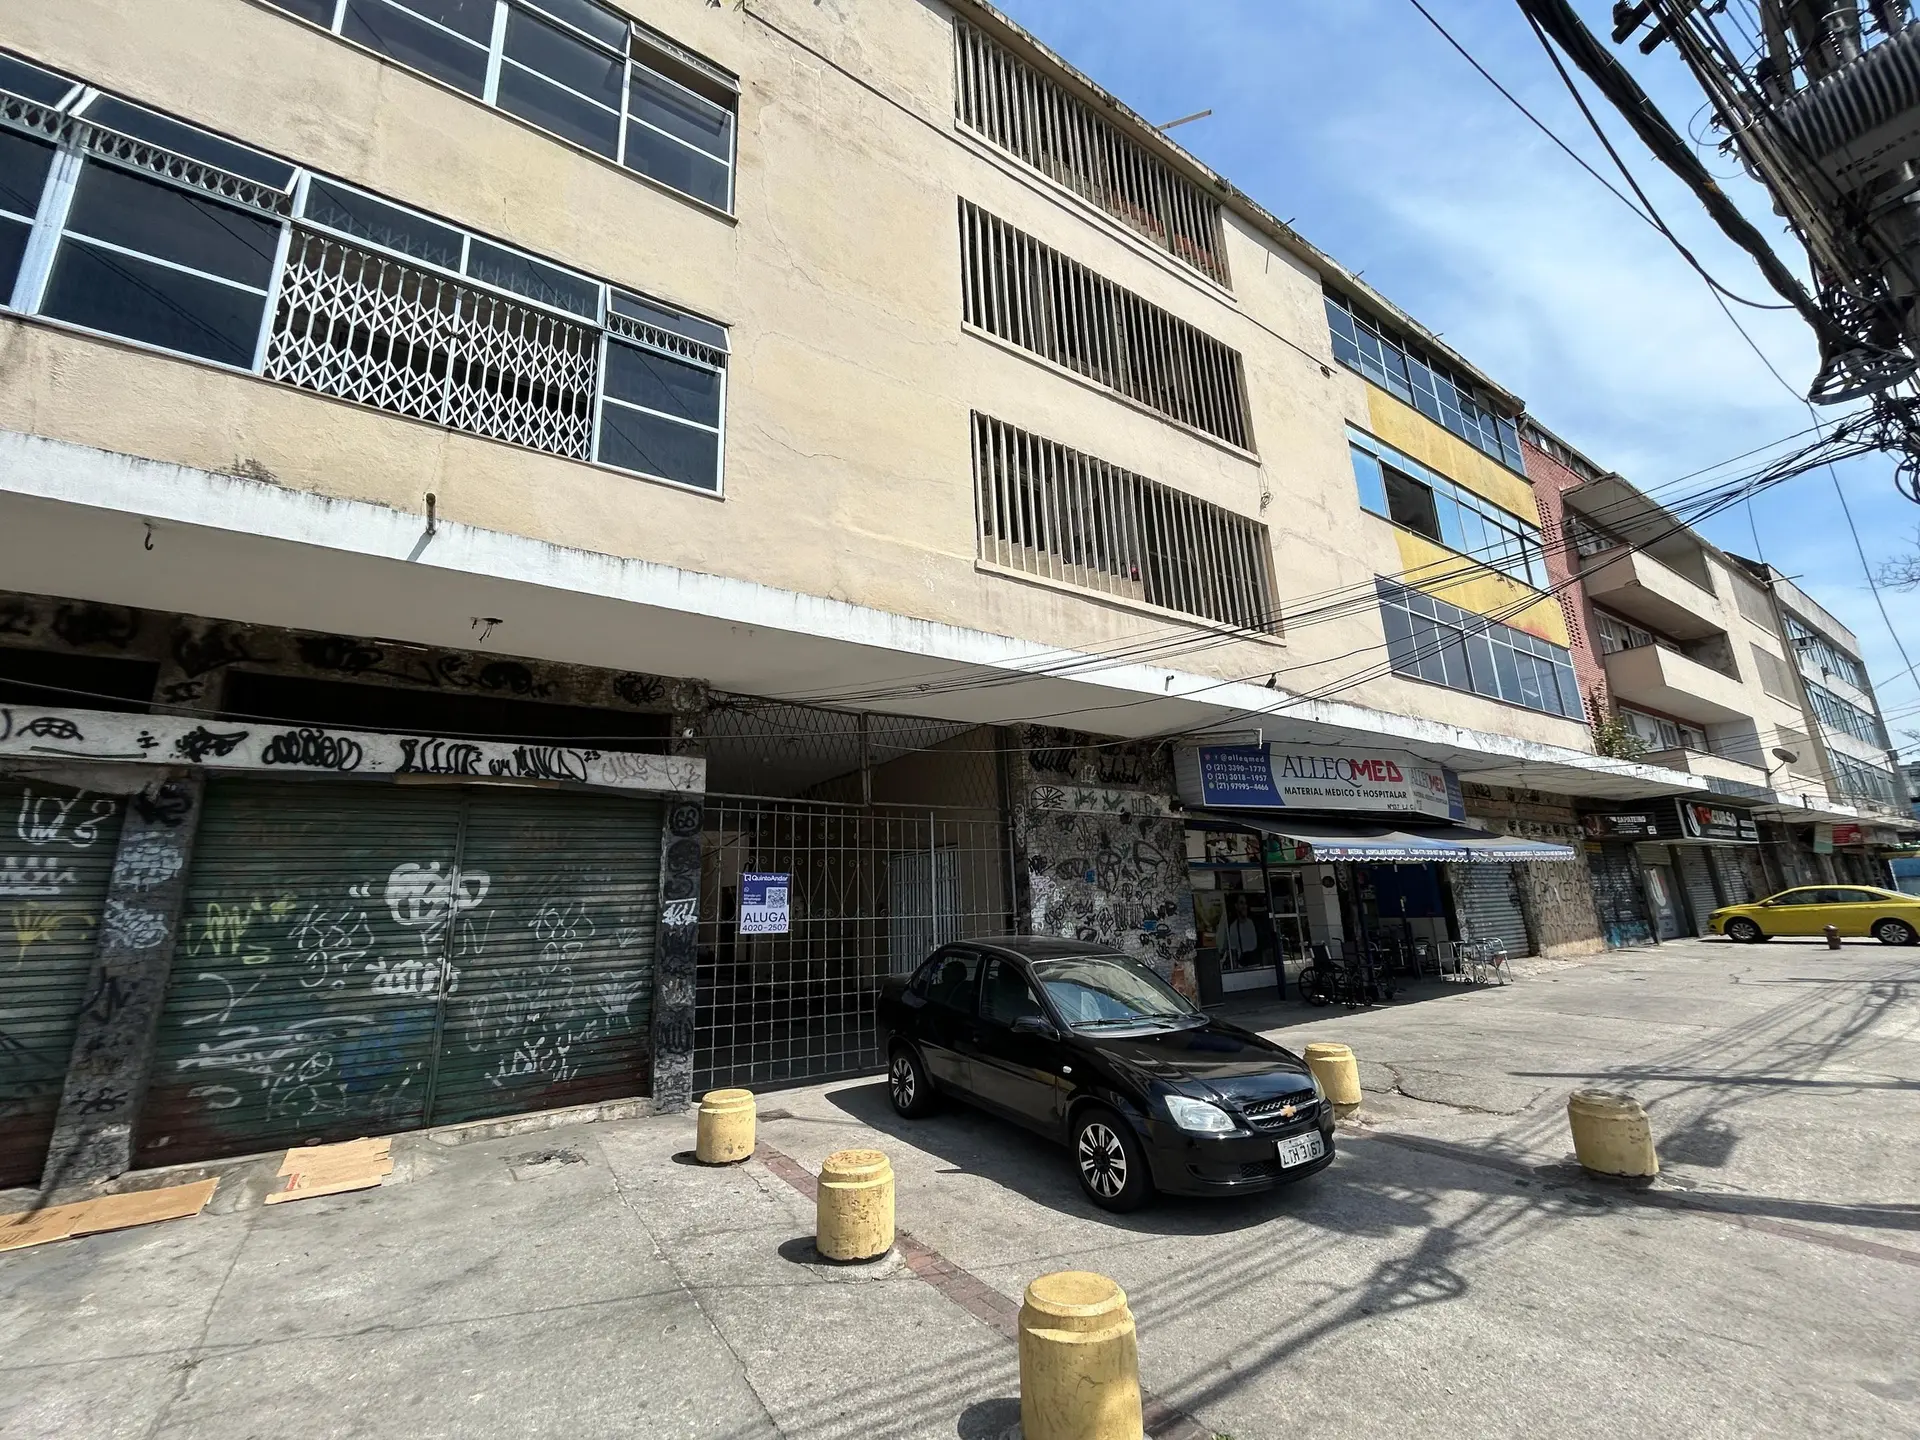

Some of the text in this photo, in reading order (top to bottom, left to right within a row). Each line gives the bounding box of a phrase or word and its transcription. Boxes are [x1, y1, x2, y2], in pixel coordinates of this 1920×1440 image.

[1213, 763, 1227, 772] (21)
[1281, 754, 1404, 788] ALLEQMED
[1215, 772, 1228, 782] (21)
[1216, 781, 1229, 791] (21)
[1284, 787, 1323, 796] MATERIAL
[1357, 789, 1362, 797] E
[1363, 790, 1408, 799] HOSPITALAR
[744, 912, 787, 923] ALUGA
